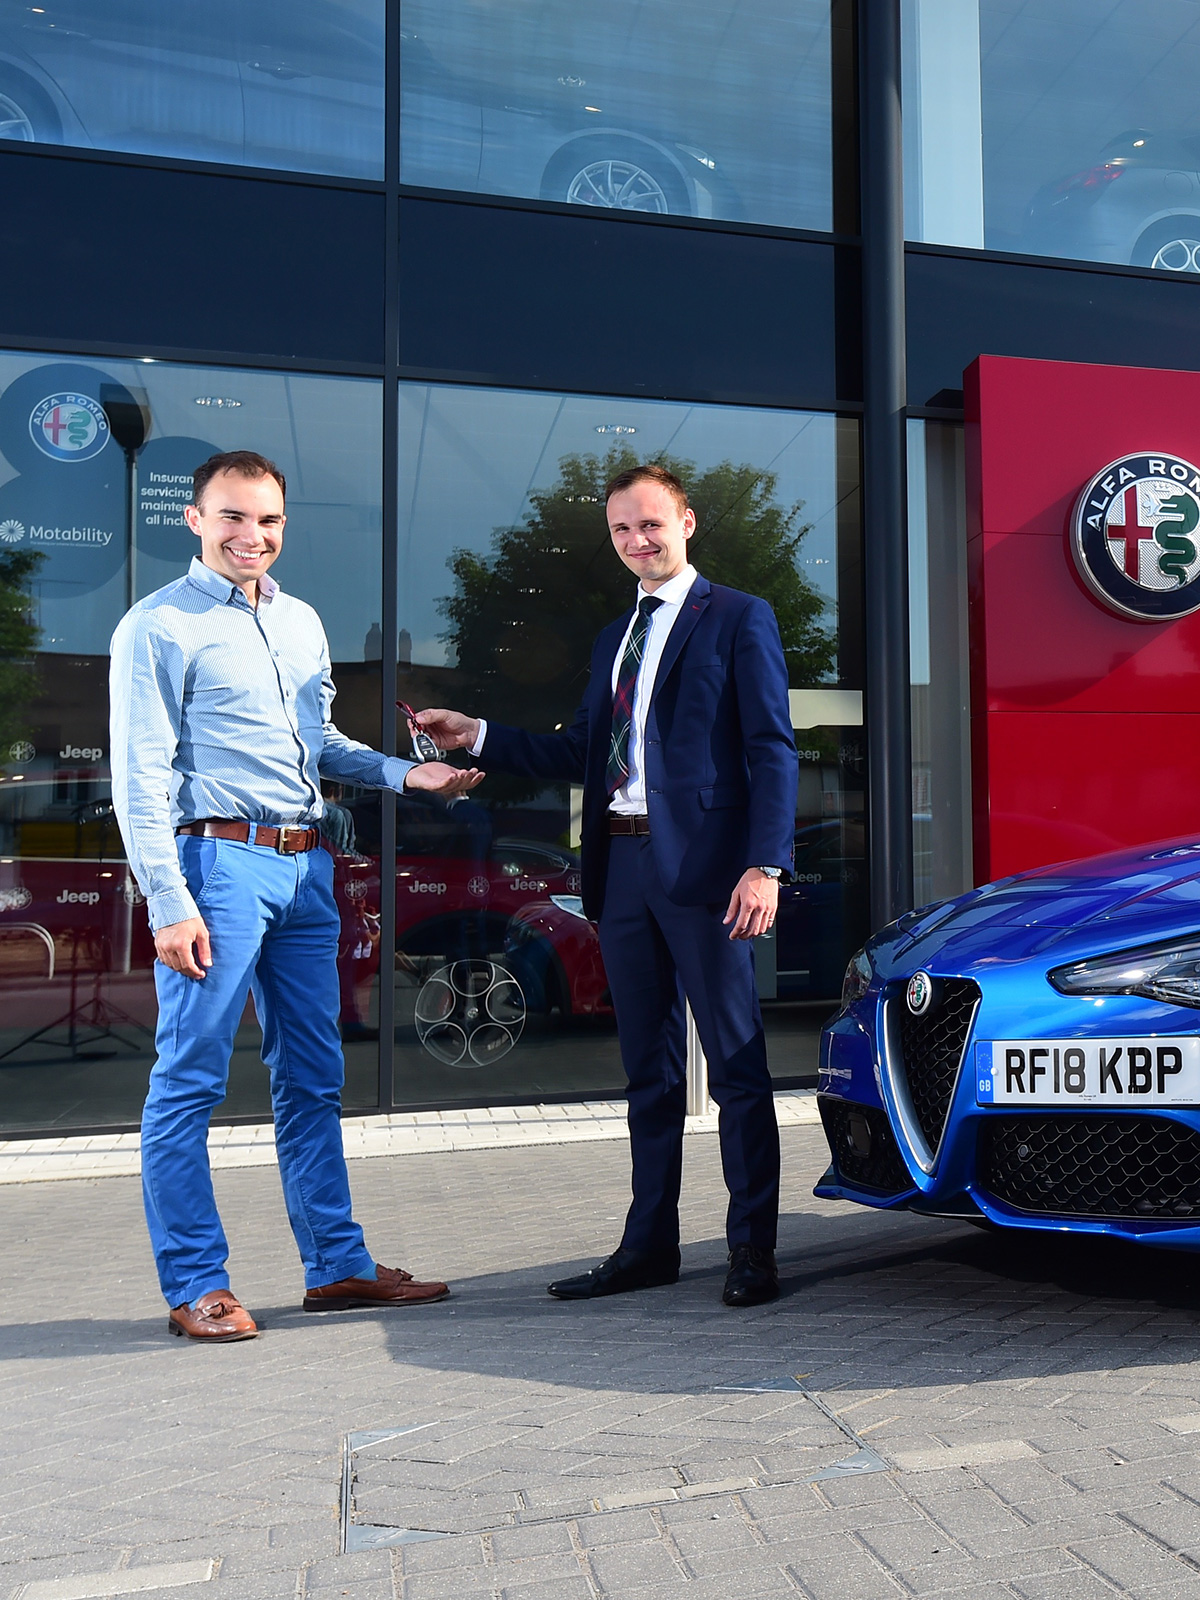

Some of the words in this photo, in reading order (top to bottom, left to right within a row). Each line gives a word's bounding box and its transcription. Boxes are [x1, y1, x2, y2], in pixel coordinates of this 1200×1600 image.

[33, 398, 60, 426] ALFA
[66, 395, 107, 431] ROMEO
[149, 472, 195, 484] Insuran
[141, 486, 193, 501] servicing
[1086, 466, 1137, 532] ALFA
[145, 514, 160, 525] all
[29, 525, 113, 546] Motability
[59, 744, 103, 761] Jeep
[797, 749, 821, 761] eep
[510, 878, 546, 893] Jeep
[790, 871, 822, 885] Jeep
[408, 880, 447, 895] Jeep
[56, 889, 100, 906] Jeep
[1005, 1048, 1087, 1094] RF18
[1099, 1047, 1182, 1094] KBP
[979, 1079, 991, 1092] GB
